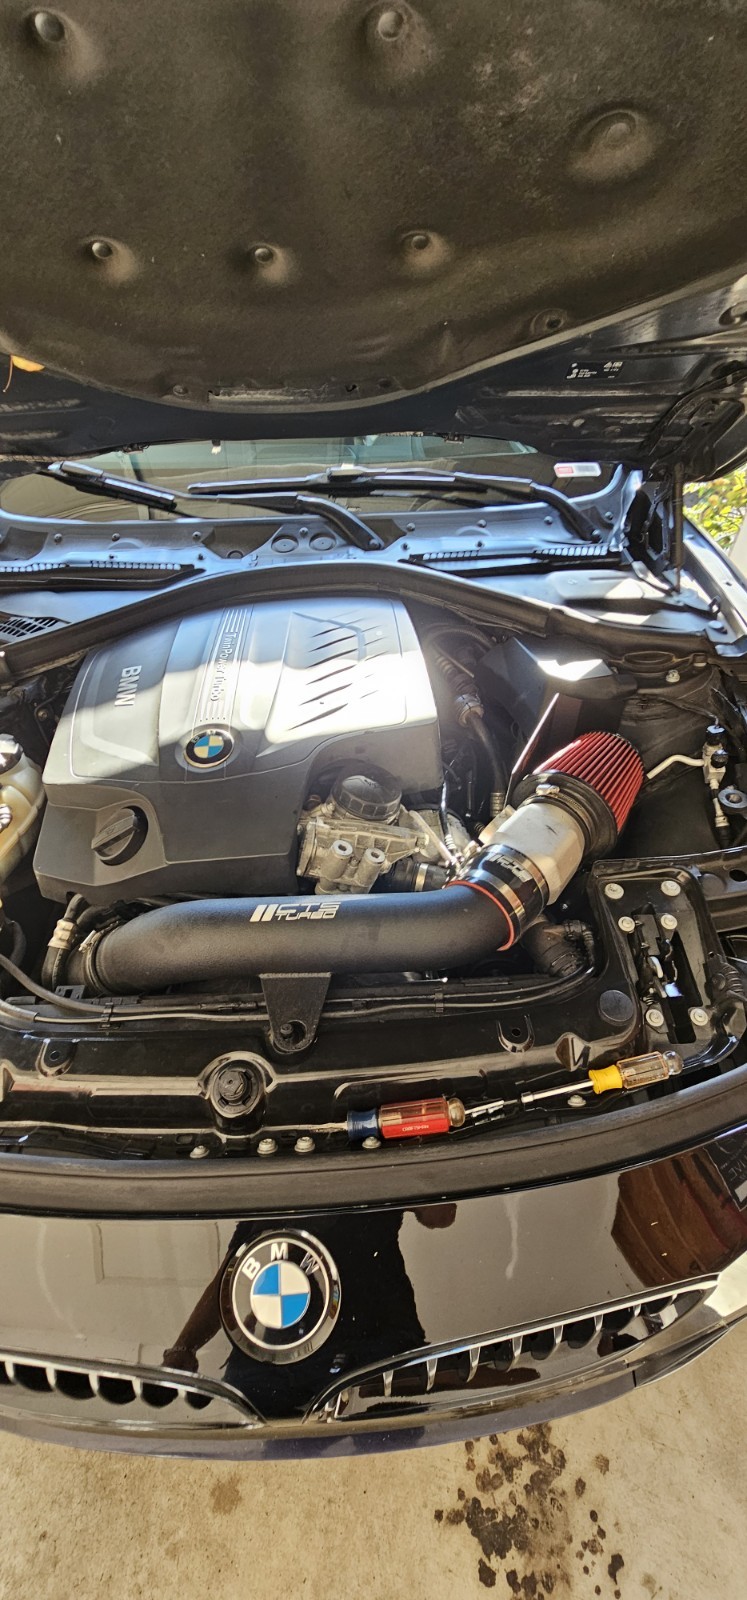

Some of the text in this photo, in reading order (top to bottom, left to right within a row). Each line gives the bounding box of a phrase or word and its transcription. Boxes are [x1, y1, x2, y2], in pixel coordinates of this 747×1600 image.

[215, 631, 238, 674] TwinPower
[114, 665, 142, 707] BMW
[275, 910, 337, 921] TURBO
[277, 902, 341, 913] CTS
[241, 1242, 321, 1281] BMW
